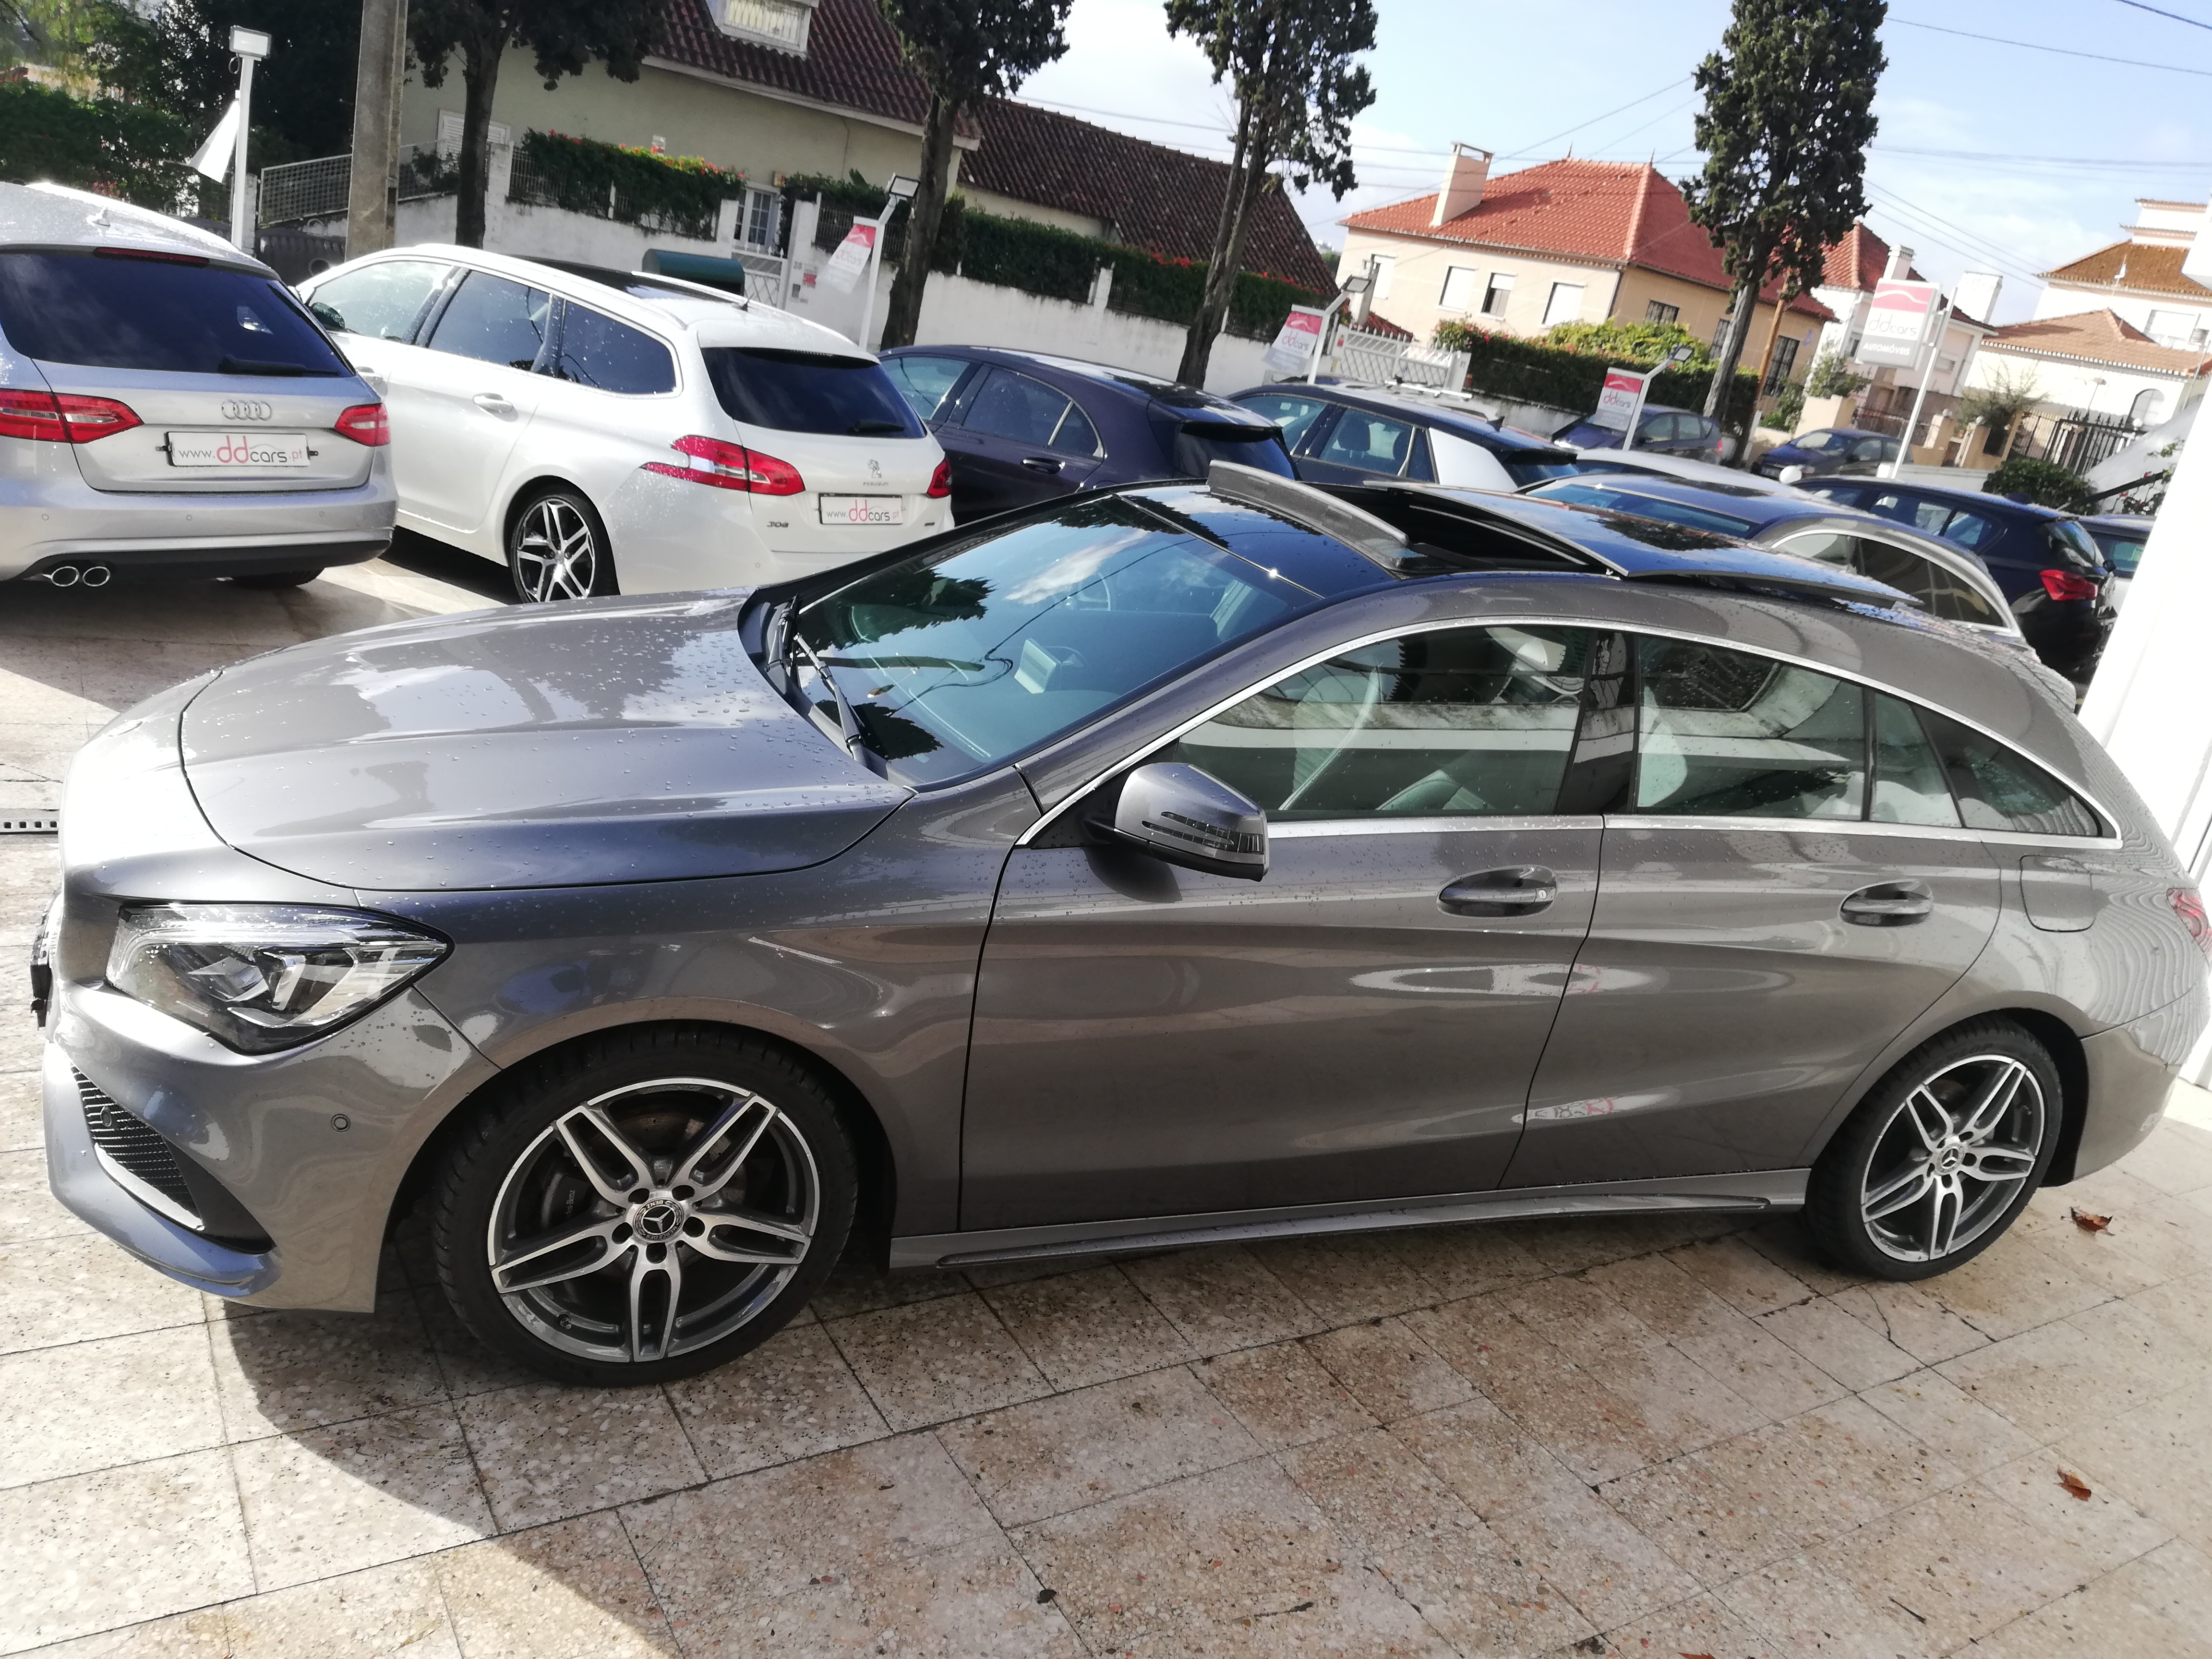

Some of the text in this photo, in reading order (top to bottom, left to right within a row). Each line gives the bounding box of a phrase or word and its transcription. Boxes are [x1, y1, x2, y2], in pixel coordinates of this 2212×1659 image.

[1868, 313, 1917, 336] ddcars
[1863, 342, 1911, 356] AUTOMÓVEIS
[179, 435, 302, 463] www.ddcars.pt
[646, 1200, 663, 1209] BENZ
[646, 1226, 678, 1240] MERCEDES
